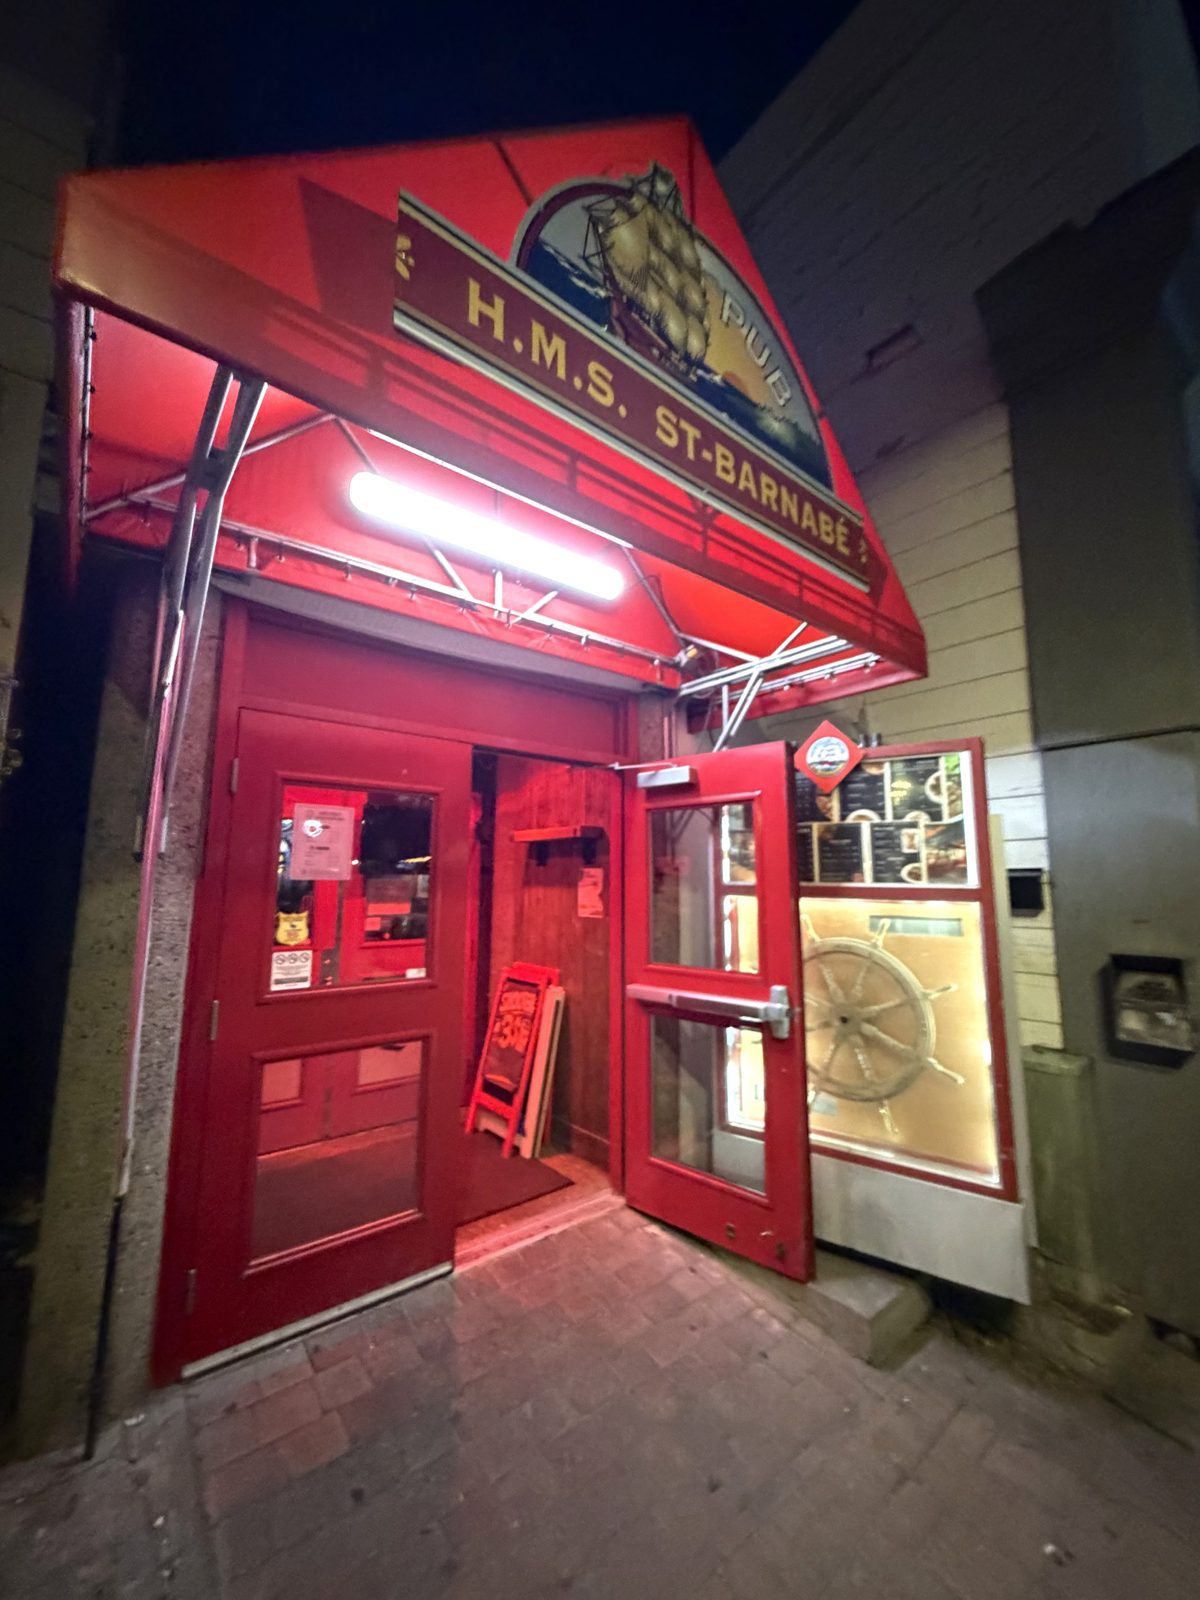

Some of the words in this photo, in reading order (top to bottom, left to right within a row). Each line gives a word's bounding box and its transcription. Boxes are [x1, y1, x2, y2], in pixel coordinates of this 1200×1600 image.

[468, 277, 627, 418] H.M.S.
[655, 405, 850, 556] ST-BARNABÉ
[720, 291, 792, 407] PUB
